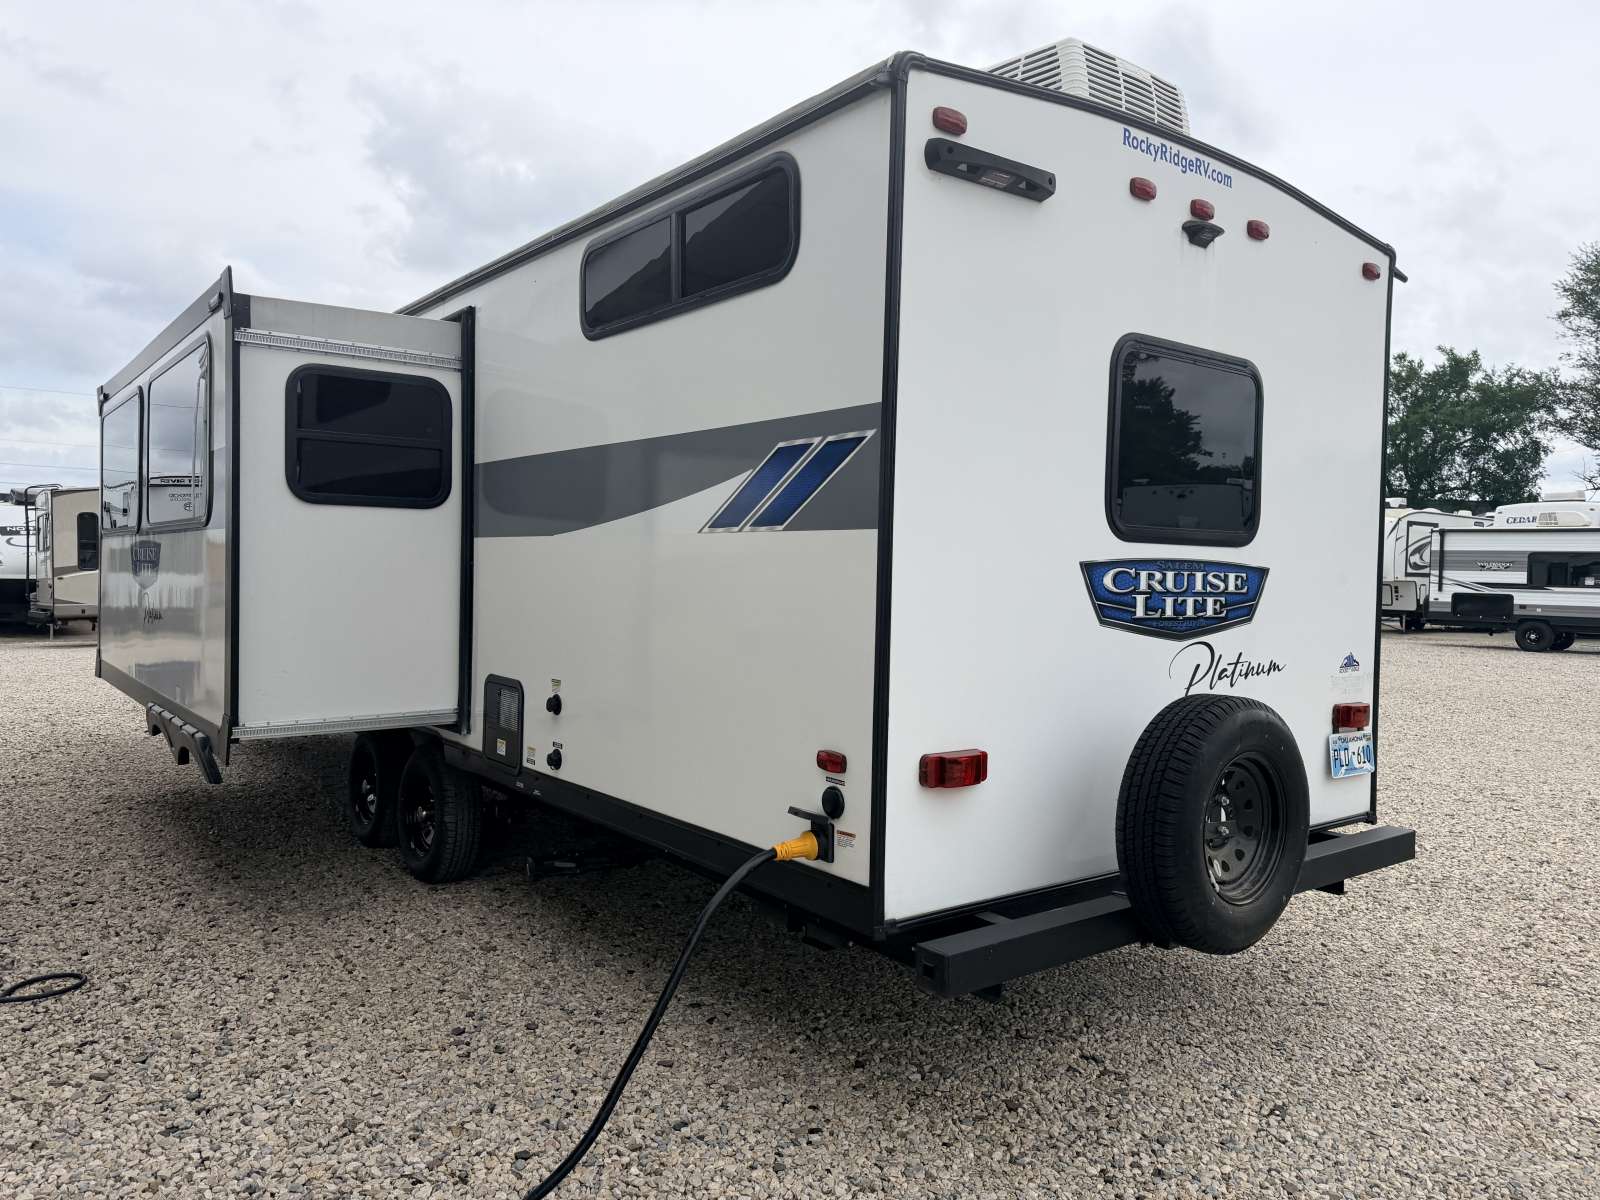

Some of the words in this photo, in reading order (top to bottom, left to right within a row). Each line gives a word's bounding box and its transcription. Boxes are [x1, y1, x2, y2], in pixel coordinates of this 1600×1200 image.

[1122, 127, 1233, 188] RockyRidgeRV.com
[1506, 516, 1537, 524] CEDAR
[1157, 560, 1205, 570] SALEM
[1102, 567, 1248, 594] CRUISE
[1131, 594, 1227, 619] LITE
[1168, 640, 1287, 697] Platinum
